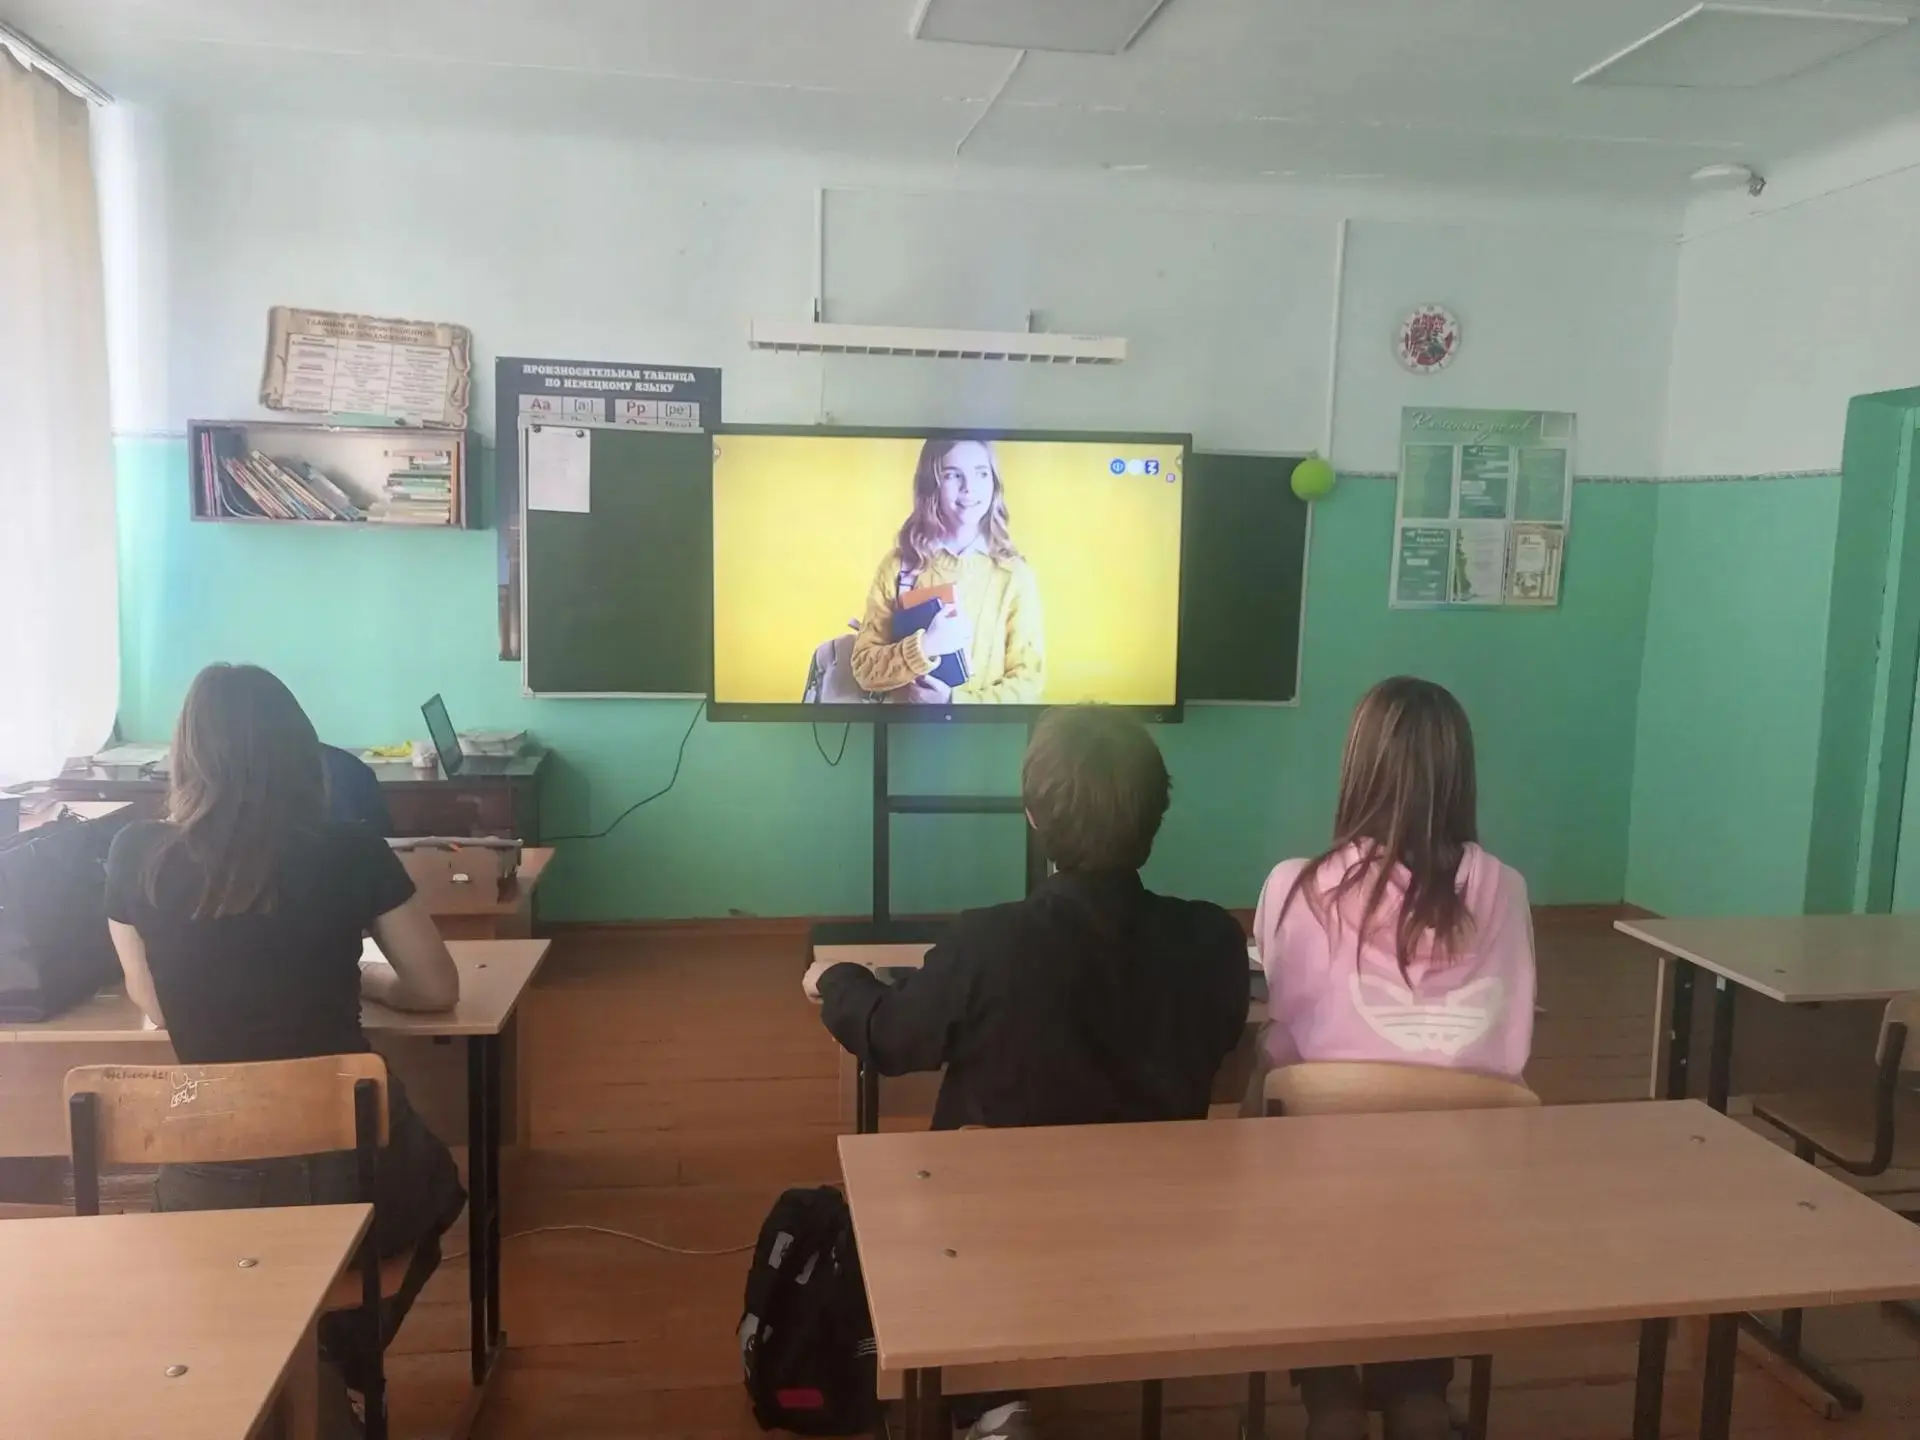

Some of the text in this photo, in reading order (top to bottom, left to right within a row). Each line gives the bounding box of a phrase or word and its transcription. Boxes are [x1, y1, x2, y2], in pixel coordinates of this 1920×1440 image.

[522, 364, 696, 383] ПРОИЗНОСИТЕЛЬНАЯ ТАБЛИЦА
[544, 378, 674, 393] ПО НЕМЕЦКОМУ ЯЗЫКУ
[530, 397, 551, 410] Aa
[626, 400, 646, 416] Pp
